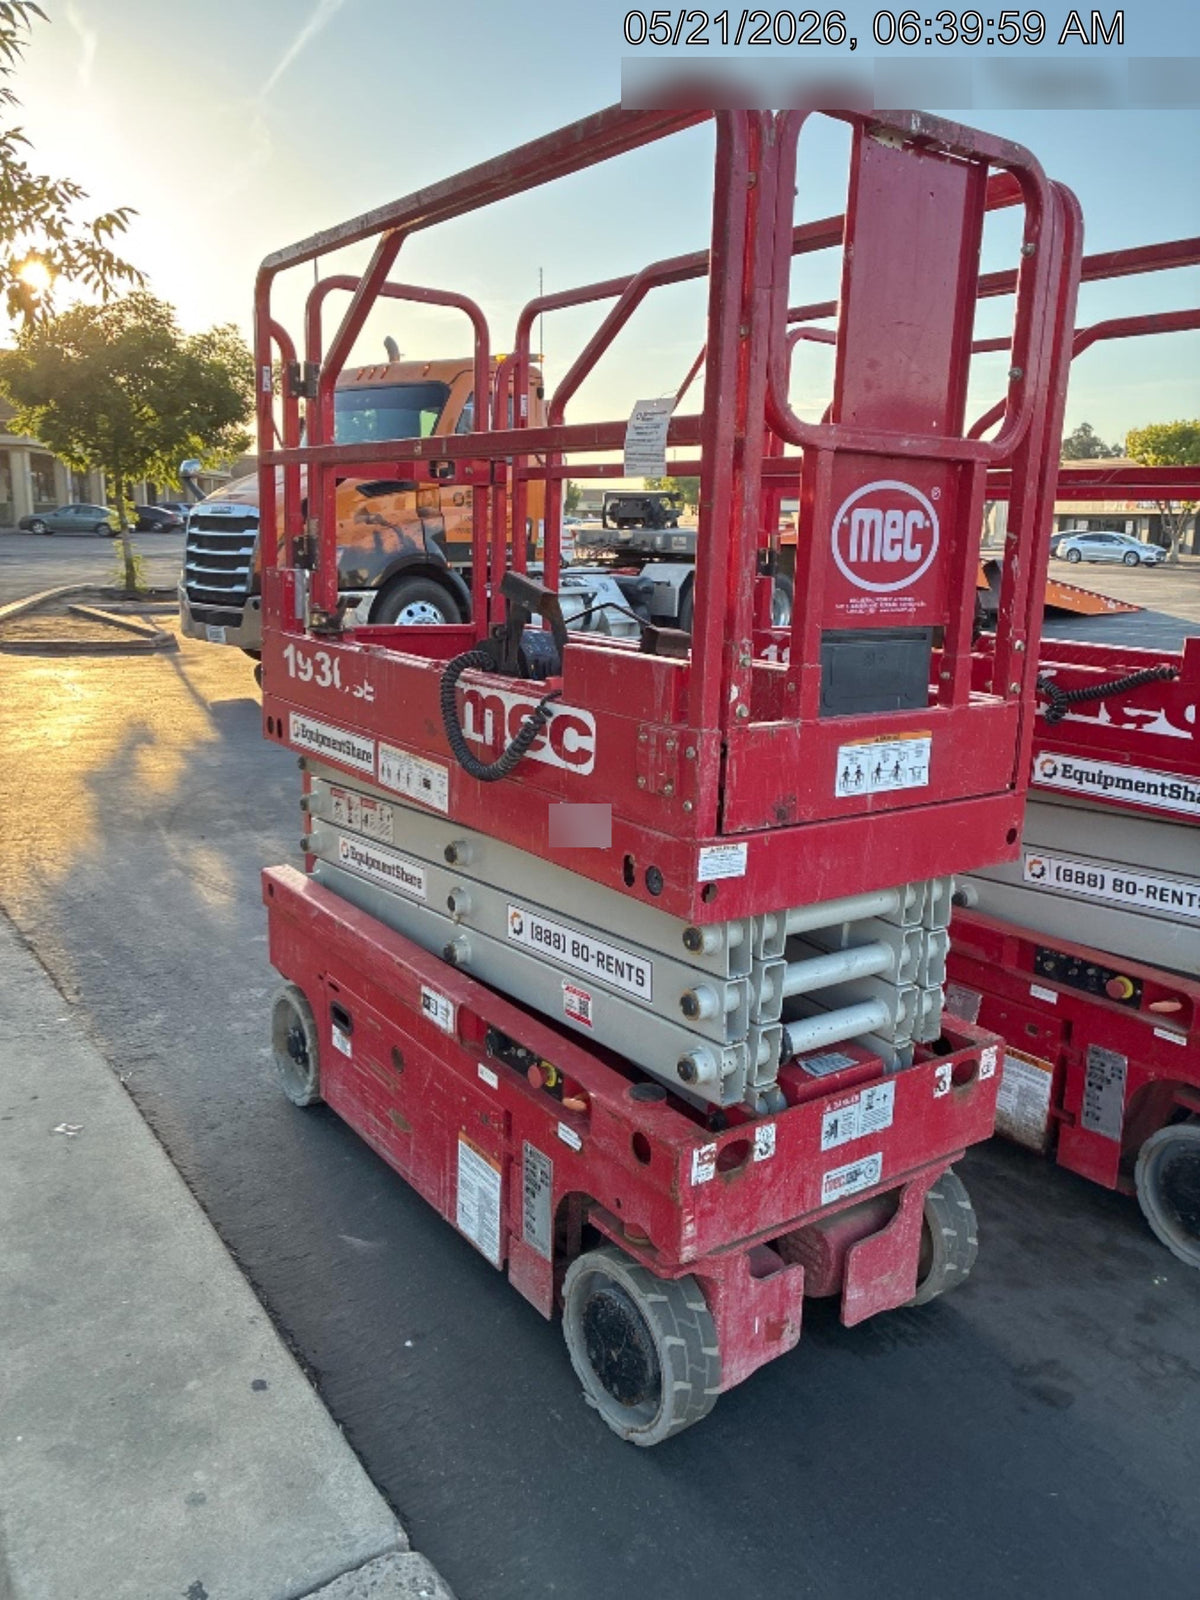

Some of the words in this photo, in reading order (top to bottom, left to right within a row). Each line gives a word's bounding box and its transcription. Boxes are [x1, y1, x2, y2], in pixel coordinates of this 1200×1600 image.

[850, 508, 925, 562] mec
[1055, 865, 1105, 890] (888)
[1112, 877, 1200, 908] 80-RENT
[571, 940, 646, 988] 80-RENTS
